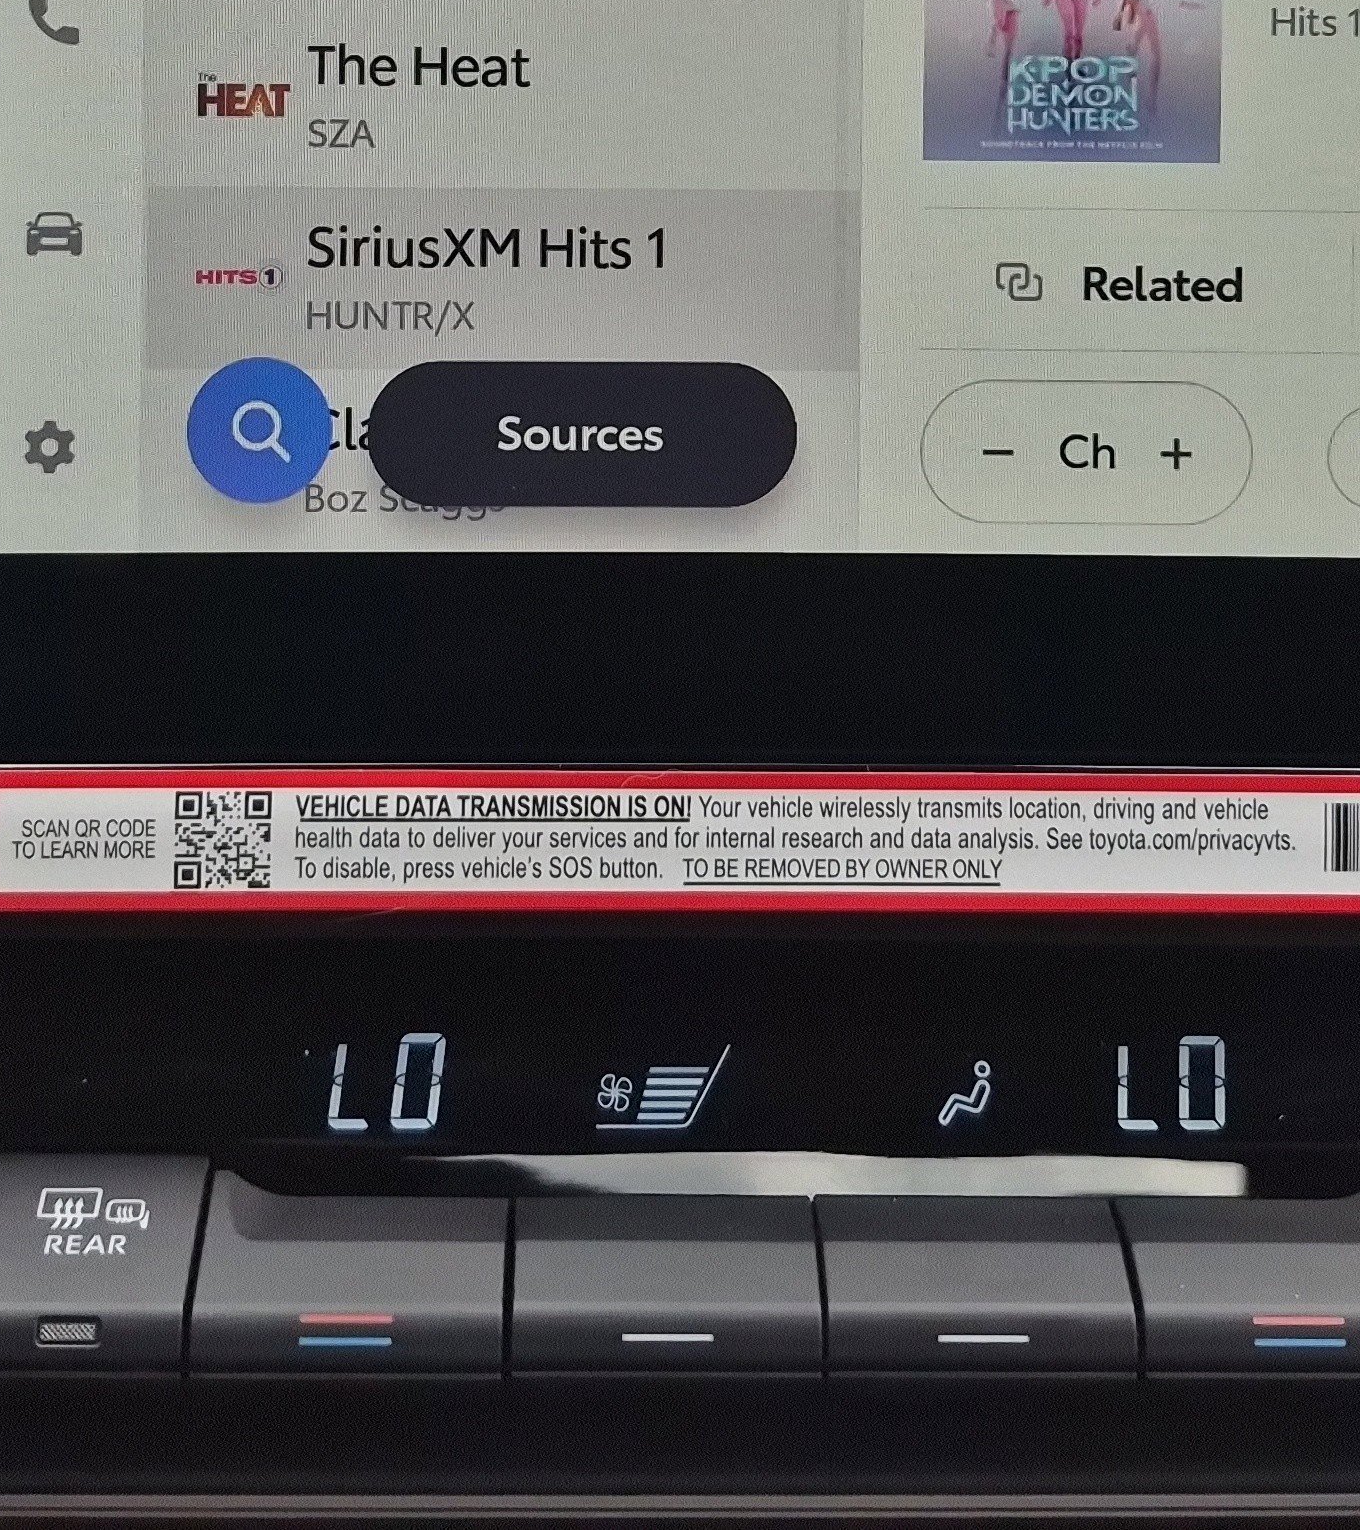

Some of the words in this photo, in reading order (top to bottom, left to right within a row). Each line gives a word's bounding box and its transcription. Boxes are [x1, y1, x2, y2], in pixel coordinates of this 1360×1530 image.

[1271, 6, 1338, 39] Hits
[1348, 7, 1360, 37] 1
[307, 42, 398, 87] The
[413, 46, 531, 88] Heat
[1008, 53, 1140, 84] KPOP
[197, 83, 292, 118] HEAT
[1007, 76, 1139, 113] DEMON
[308, 118, 376, 149] SZA
[1007, 105, 1140, 137] HUNTERS
[307, 224, 521, 269] SiriusXM
[539, 226, 632, 270] Hits
[647, 227, 664, 269] 1
[1083, 265, 1244, 303] Related
[305, 300, 475, 337] HUNTR/X
[497, 415, 664, 452] Sources
[1059, 432, 1116, 470] Ch
[304, 483, 368, 513] Boz
[295, 795, 389, 819] VEHICLE
[395, 793, 452, 819] DATA
[457, 793, 621, 820] TRANSMISSION
[628, 795, 647, 820] IS
[653, 794, 692, 820] ON!
[698, 795, 742, 819] Your
[747, 795, 813, 820] vehicle
[819, 795, 912, 824] wirelessly
[917, 795, 1003, 820] transmits
[1009, 796, 1086, 822] location,
[1093, 796, 1155, 825] driving
[1162, 796, 1196, 820] and
[1203, 798, 1269, 822] vehicle
[21, 819, 70, 839] SCAN
[74, 818, 102, 838] QR
[105, 818, 156, 838] CODE
[295, 826, 353, 850] health
[358, 826, 400, 850] data
[407, 827, 426, 850] to
[432, 825, 496, 850] deliver
[502, 830, 544, 854] your
[549, 825, 627, 850] services
[633, 826, 668, 850] and
[674, 825, 700, 850] for
[705, 826, 775, 850] internal
[781, 825, 863, 849] research
[869, 825, 904, 849] and
[910, 826, 952, 849] data
[958, 827, 1039, 856] analysis.
[1046, 826, 1083, 851] See
[1089, 827, 1296, 857] toyota.com/privacyvts.
[11, 840, 36, 860] TO
[40, 840, 99, 860] LEARN
[103, 840, 156, 860] MORE
[294, 856, 317, 880] To
[322, 856, 396, 883] disable,
[403, 861, 455, 885] press
[461, 856, 542, 880] vehicle's
[548, 854, 593, 879] SOS
[599, 855, 663, 879] button.
[682, 857, 709, 879] TO
[713, 858, 739, 879] BE
[744, 858, 841, 880] REMOVED
[845, 857, 871, 879] BY
[875, 857, 948, 879] OWNER
[952, 857, 1003, 879] ONLY
[43, 1234, 127, 1256] REAR
